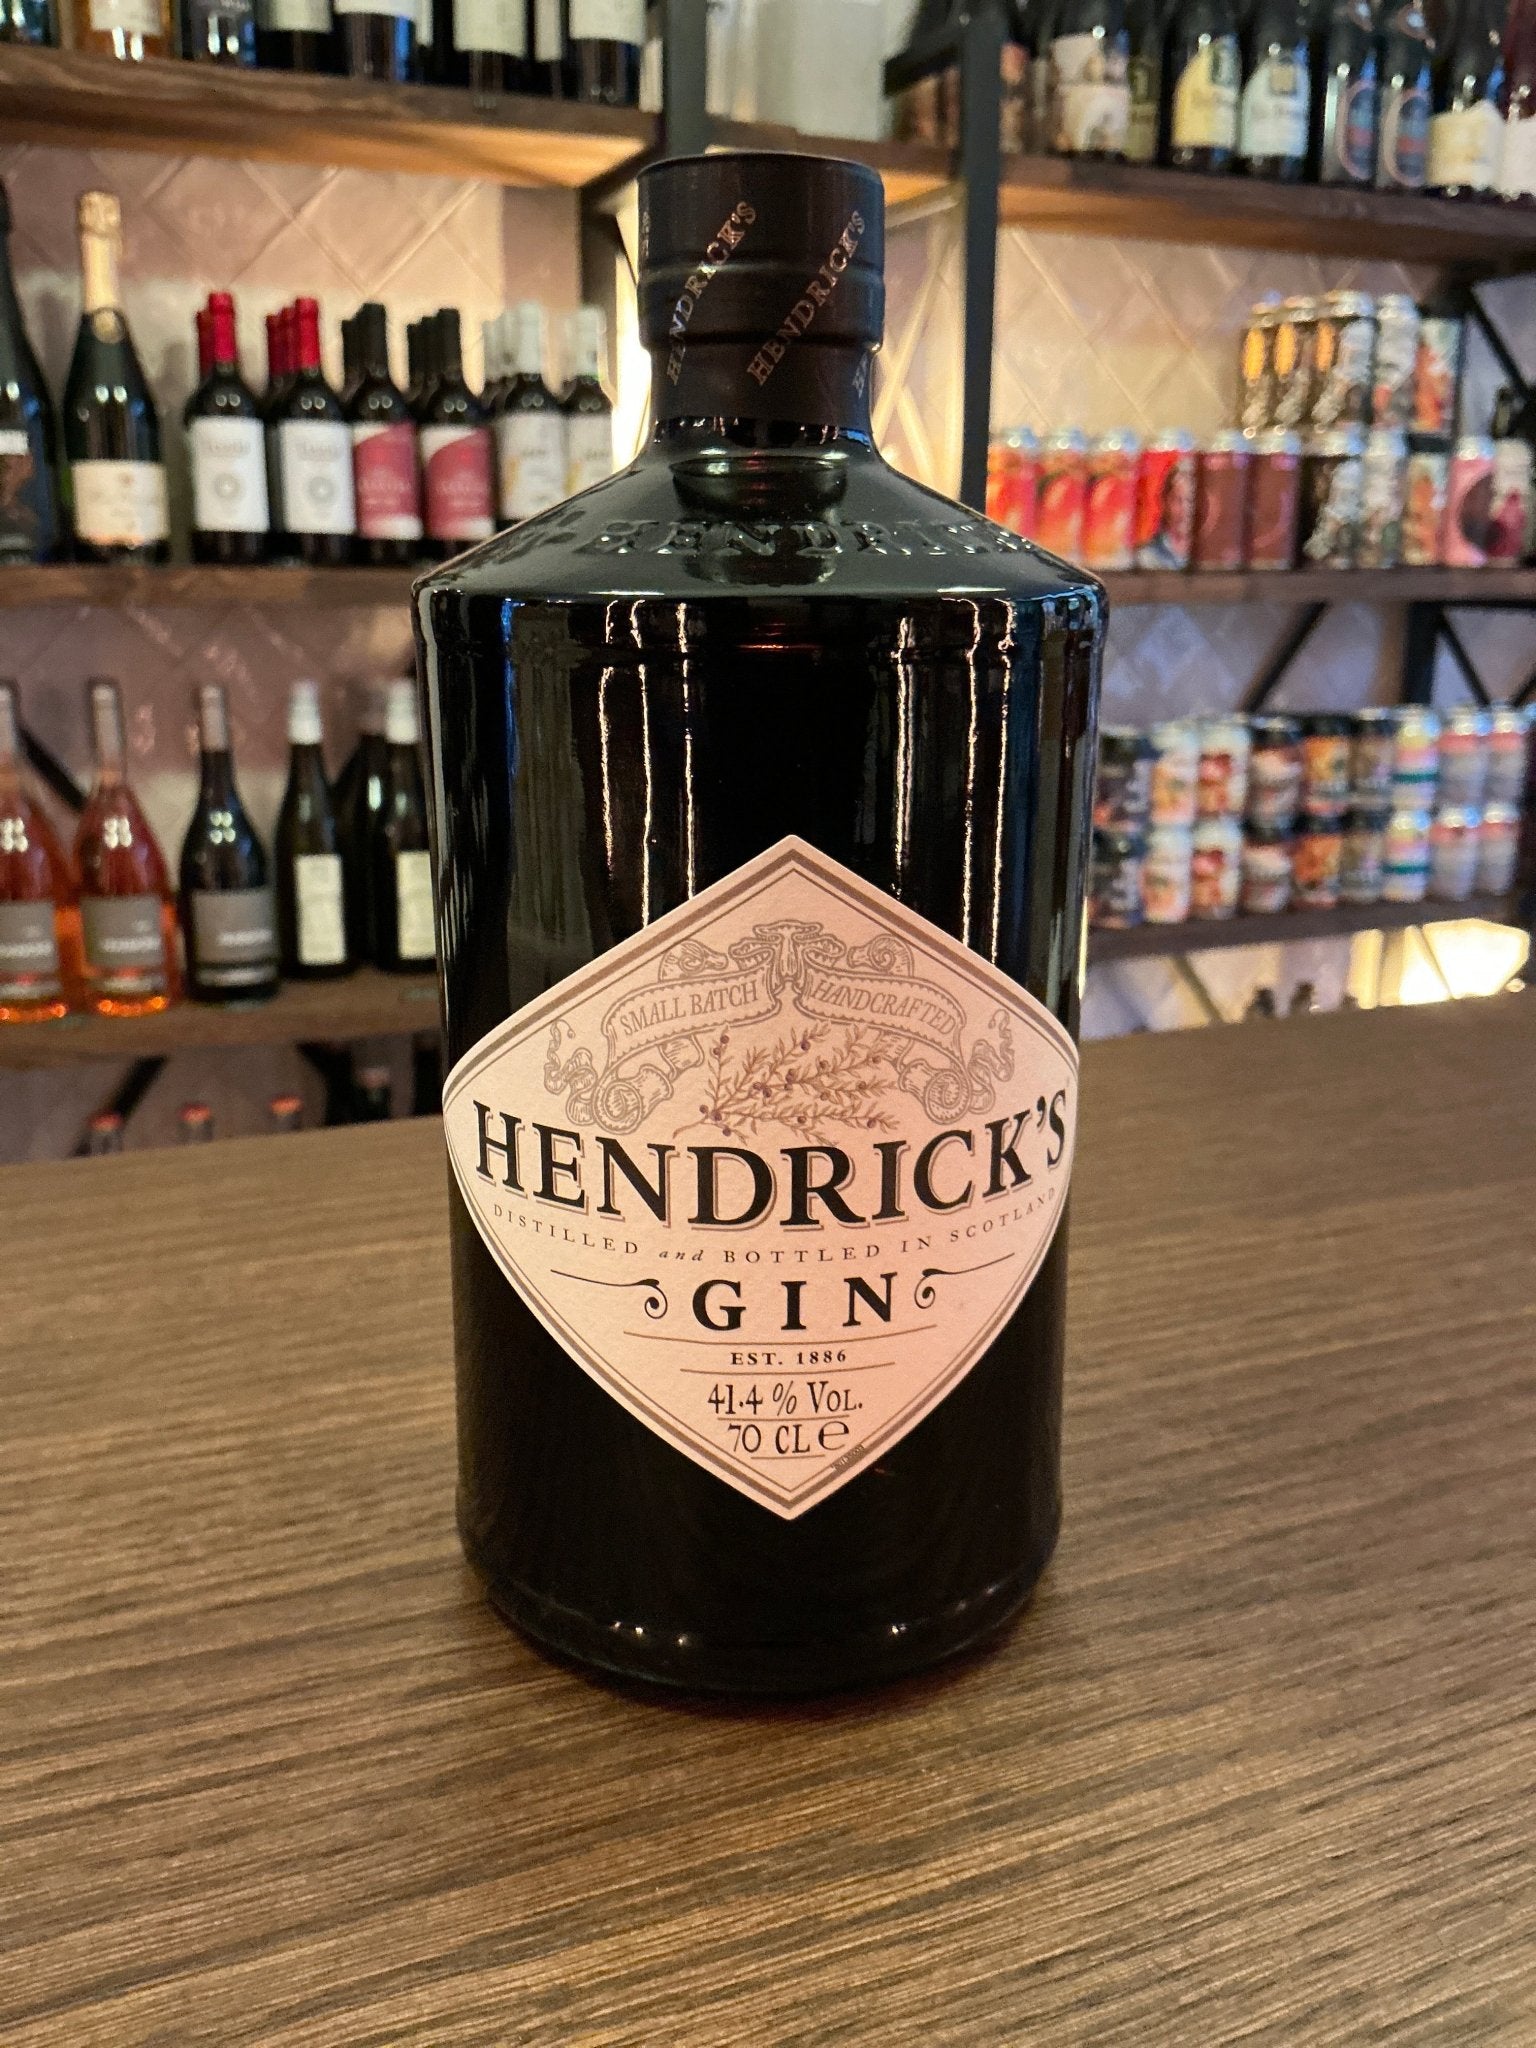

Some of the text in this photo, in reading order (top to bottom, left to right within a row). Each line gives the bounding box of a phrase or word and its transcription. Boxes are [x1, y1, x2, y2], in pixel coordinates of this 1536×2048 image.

[667, 201, 756, 386] HENDRICK'S
[747, 210, 865, 386] HENDRICK'S
[620, 979, 957, 1036] SMALL BATCH HANDCRAFTED
[473, 1089, 1067, 1231] HENDRICK'S
[494, 1187, 1055, 1263] DISTILLED and BOTTLED IN SCOTLAND
[692, 1271, 898, 1331] GIN
[731, 1350, 846, 1366] EST. 1886
[772, 1380, 797, 1416] %
[727, 1423, 762, 1454] 70
